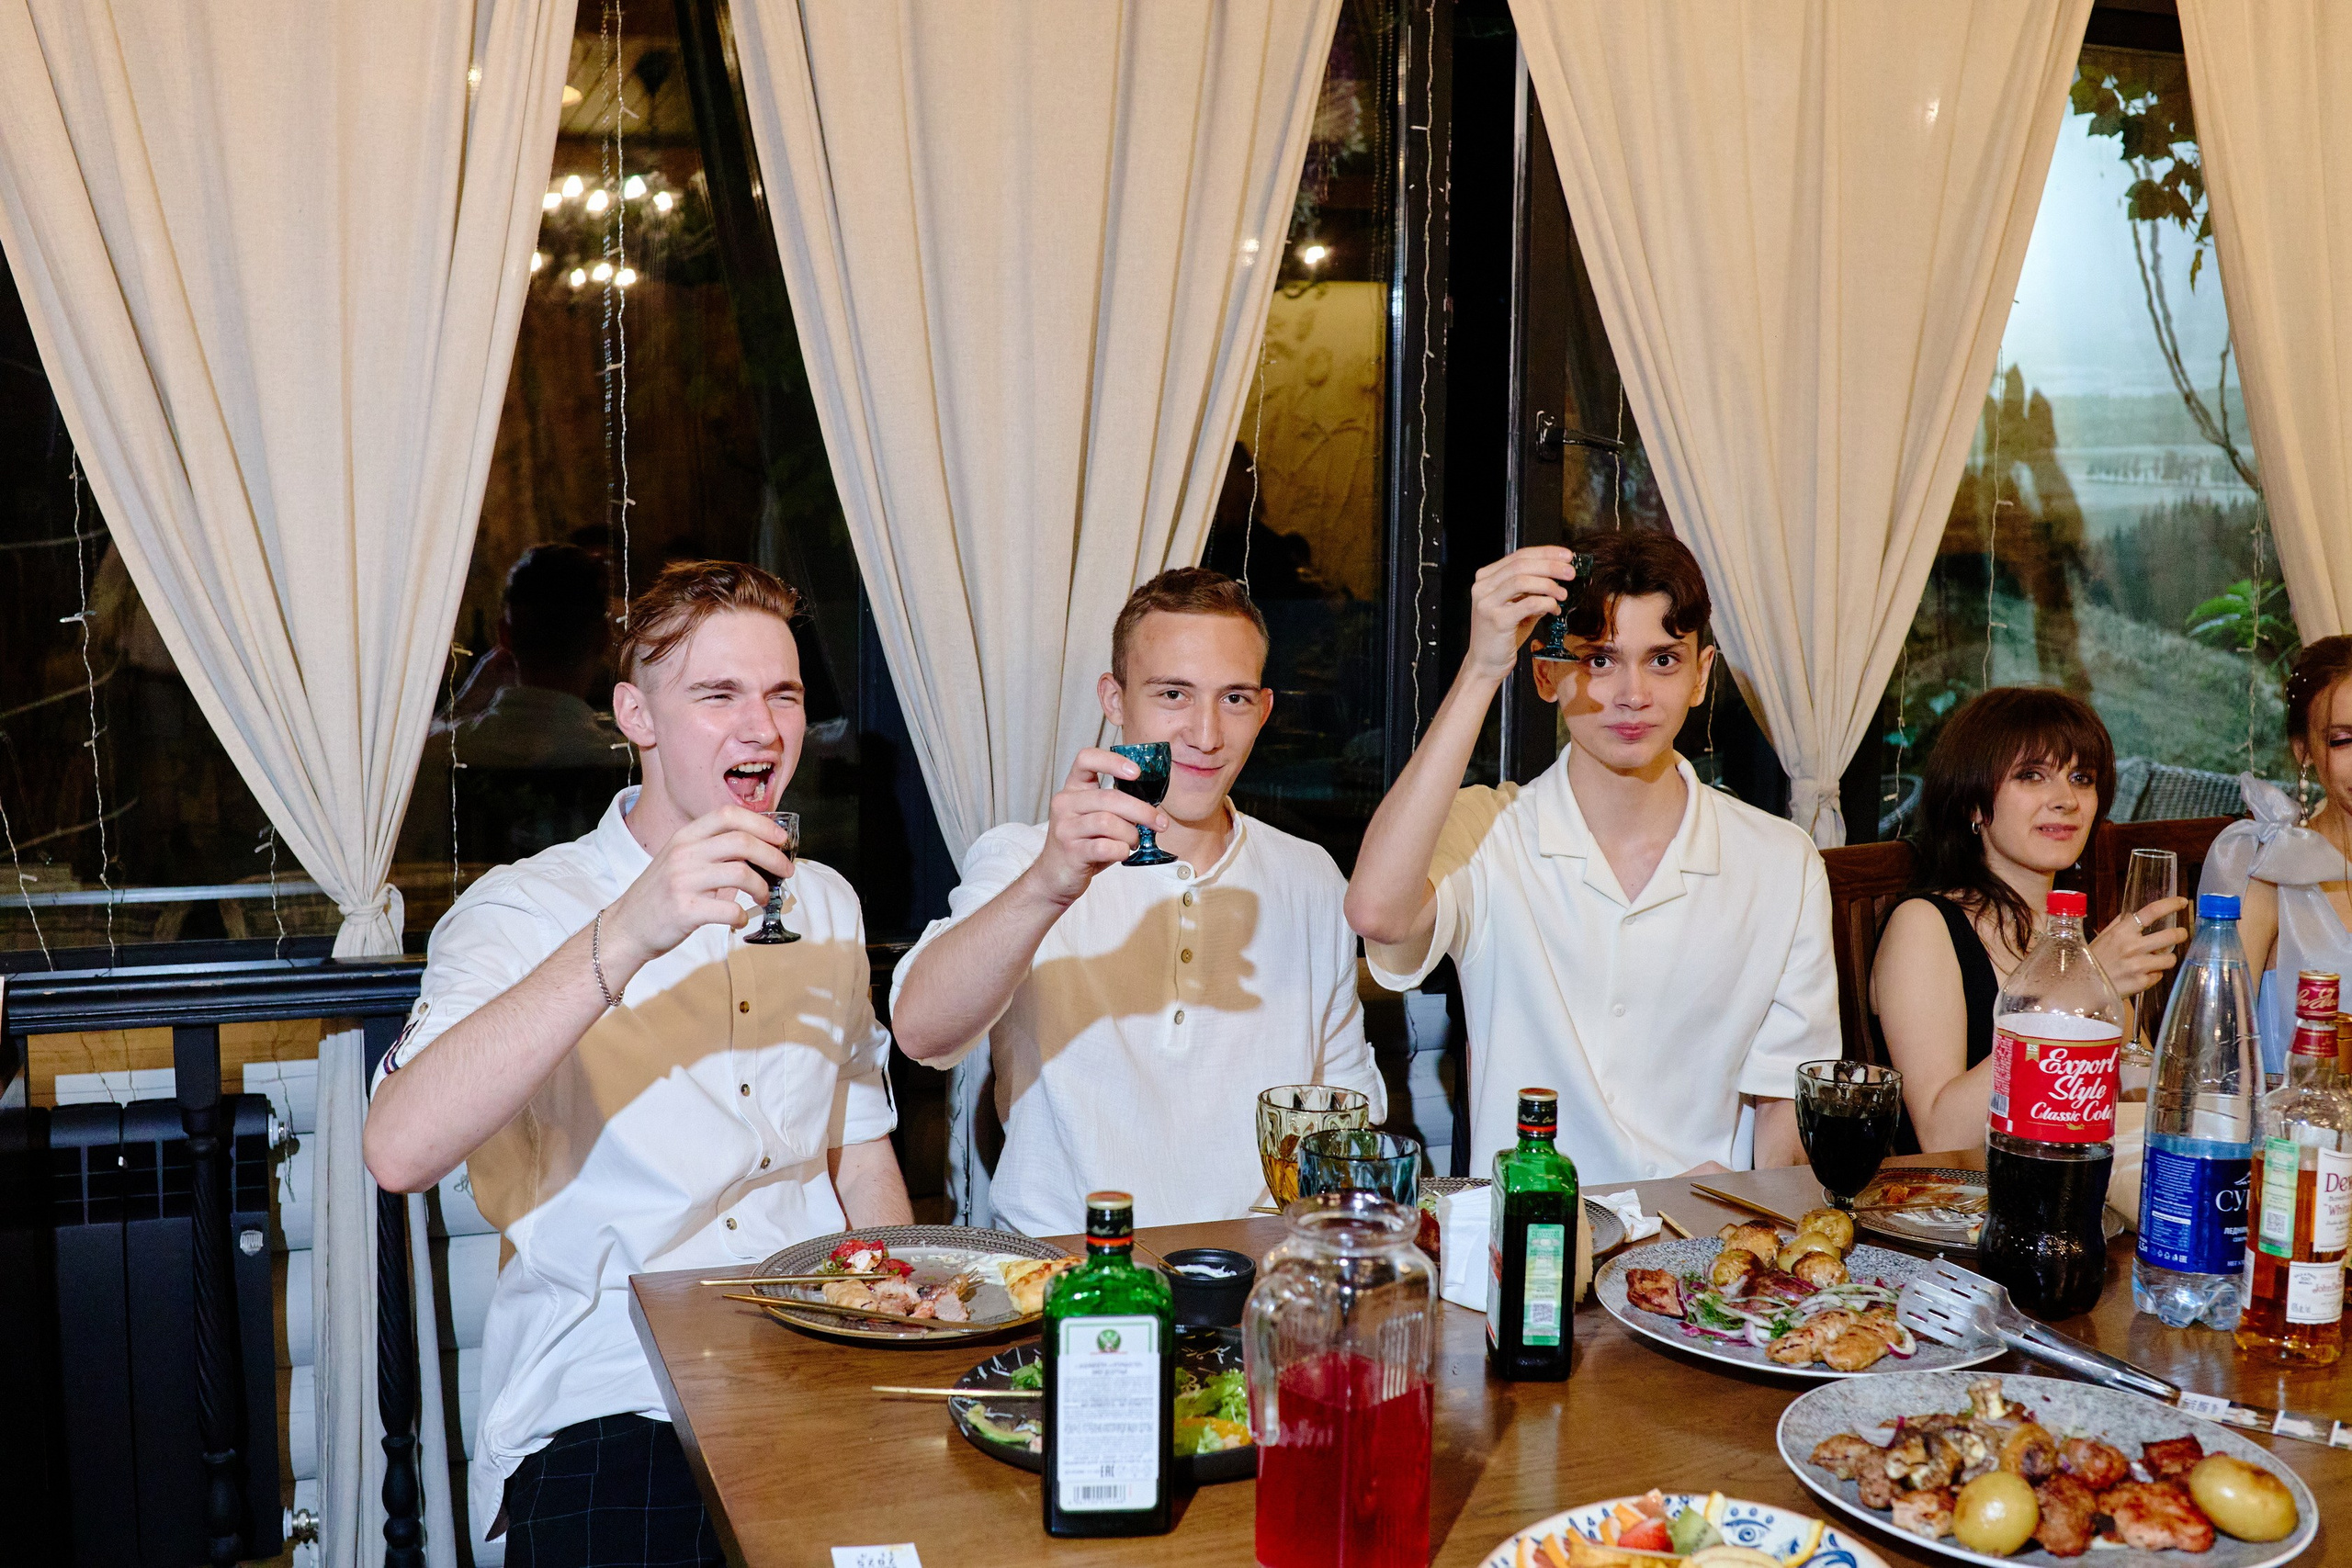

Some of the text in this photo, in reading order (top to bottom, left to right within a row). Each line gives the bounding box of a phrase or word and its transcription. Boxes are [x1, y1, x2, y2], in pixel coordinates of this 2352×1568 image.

[2039, 1047, 2119, 1089] Export
[2048, 1075, 2108, 1109] Style
[2030, 1101, 2082, 1122] Classic
